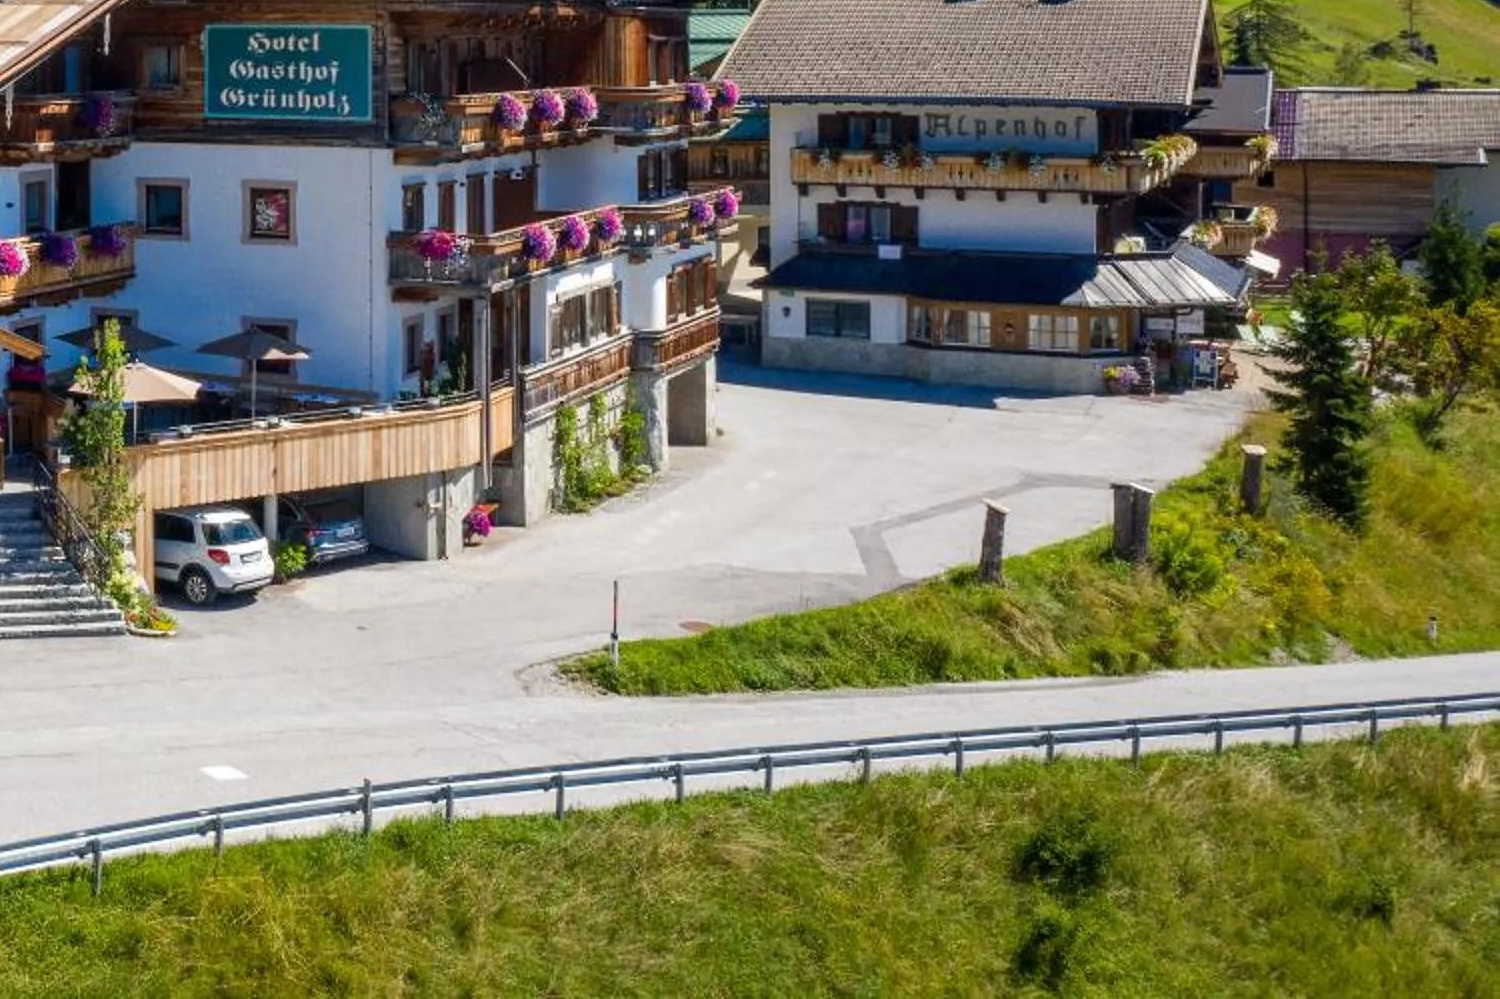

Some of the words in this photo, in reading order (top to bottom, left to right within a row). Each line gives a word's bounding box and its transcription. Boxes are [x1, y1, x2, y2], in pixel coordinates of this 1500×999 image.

[247, 32, 320, 54] Hotel
[229, 59, 340, 85] Gasthof
[219, 87, 351, 115] Grünholz
[924, 112, 1087, 140] Alpenhof
